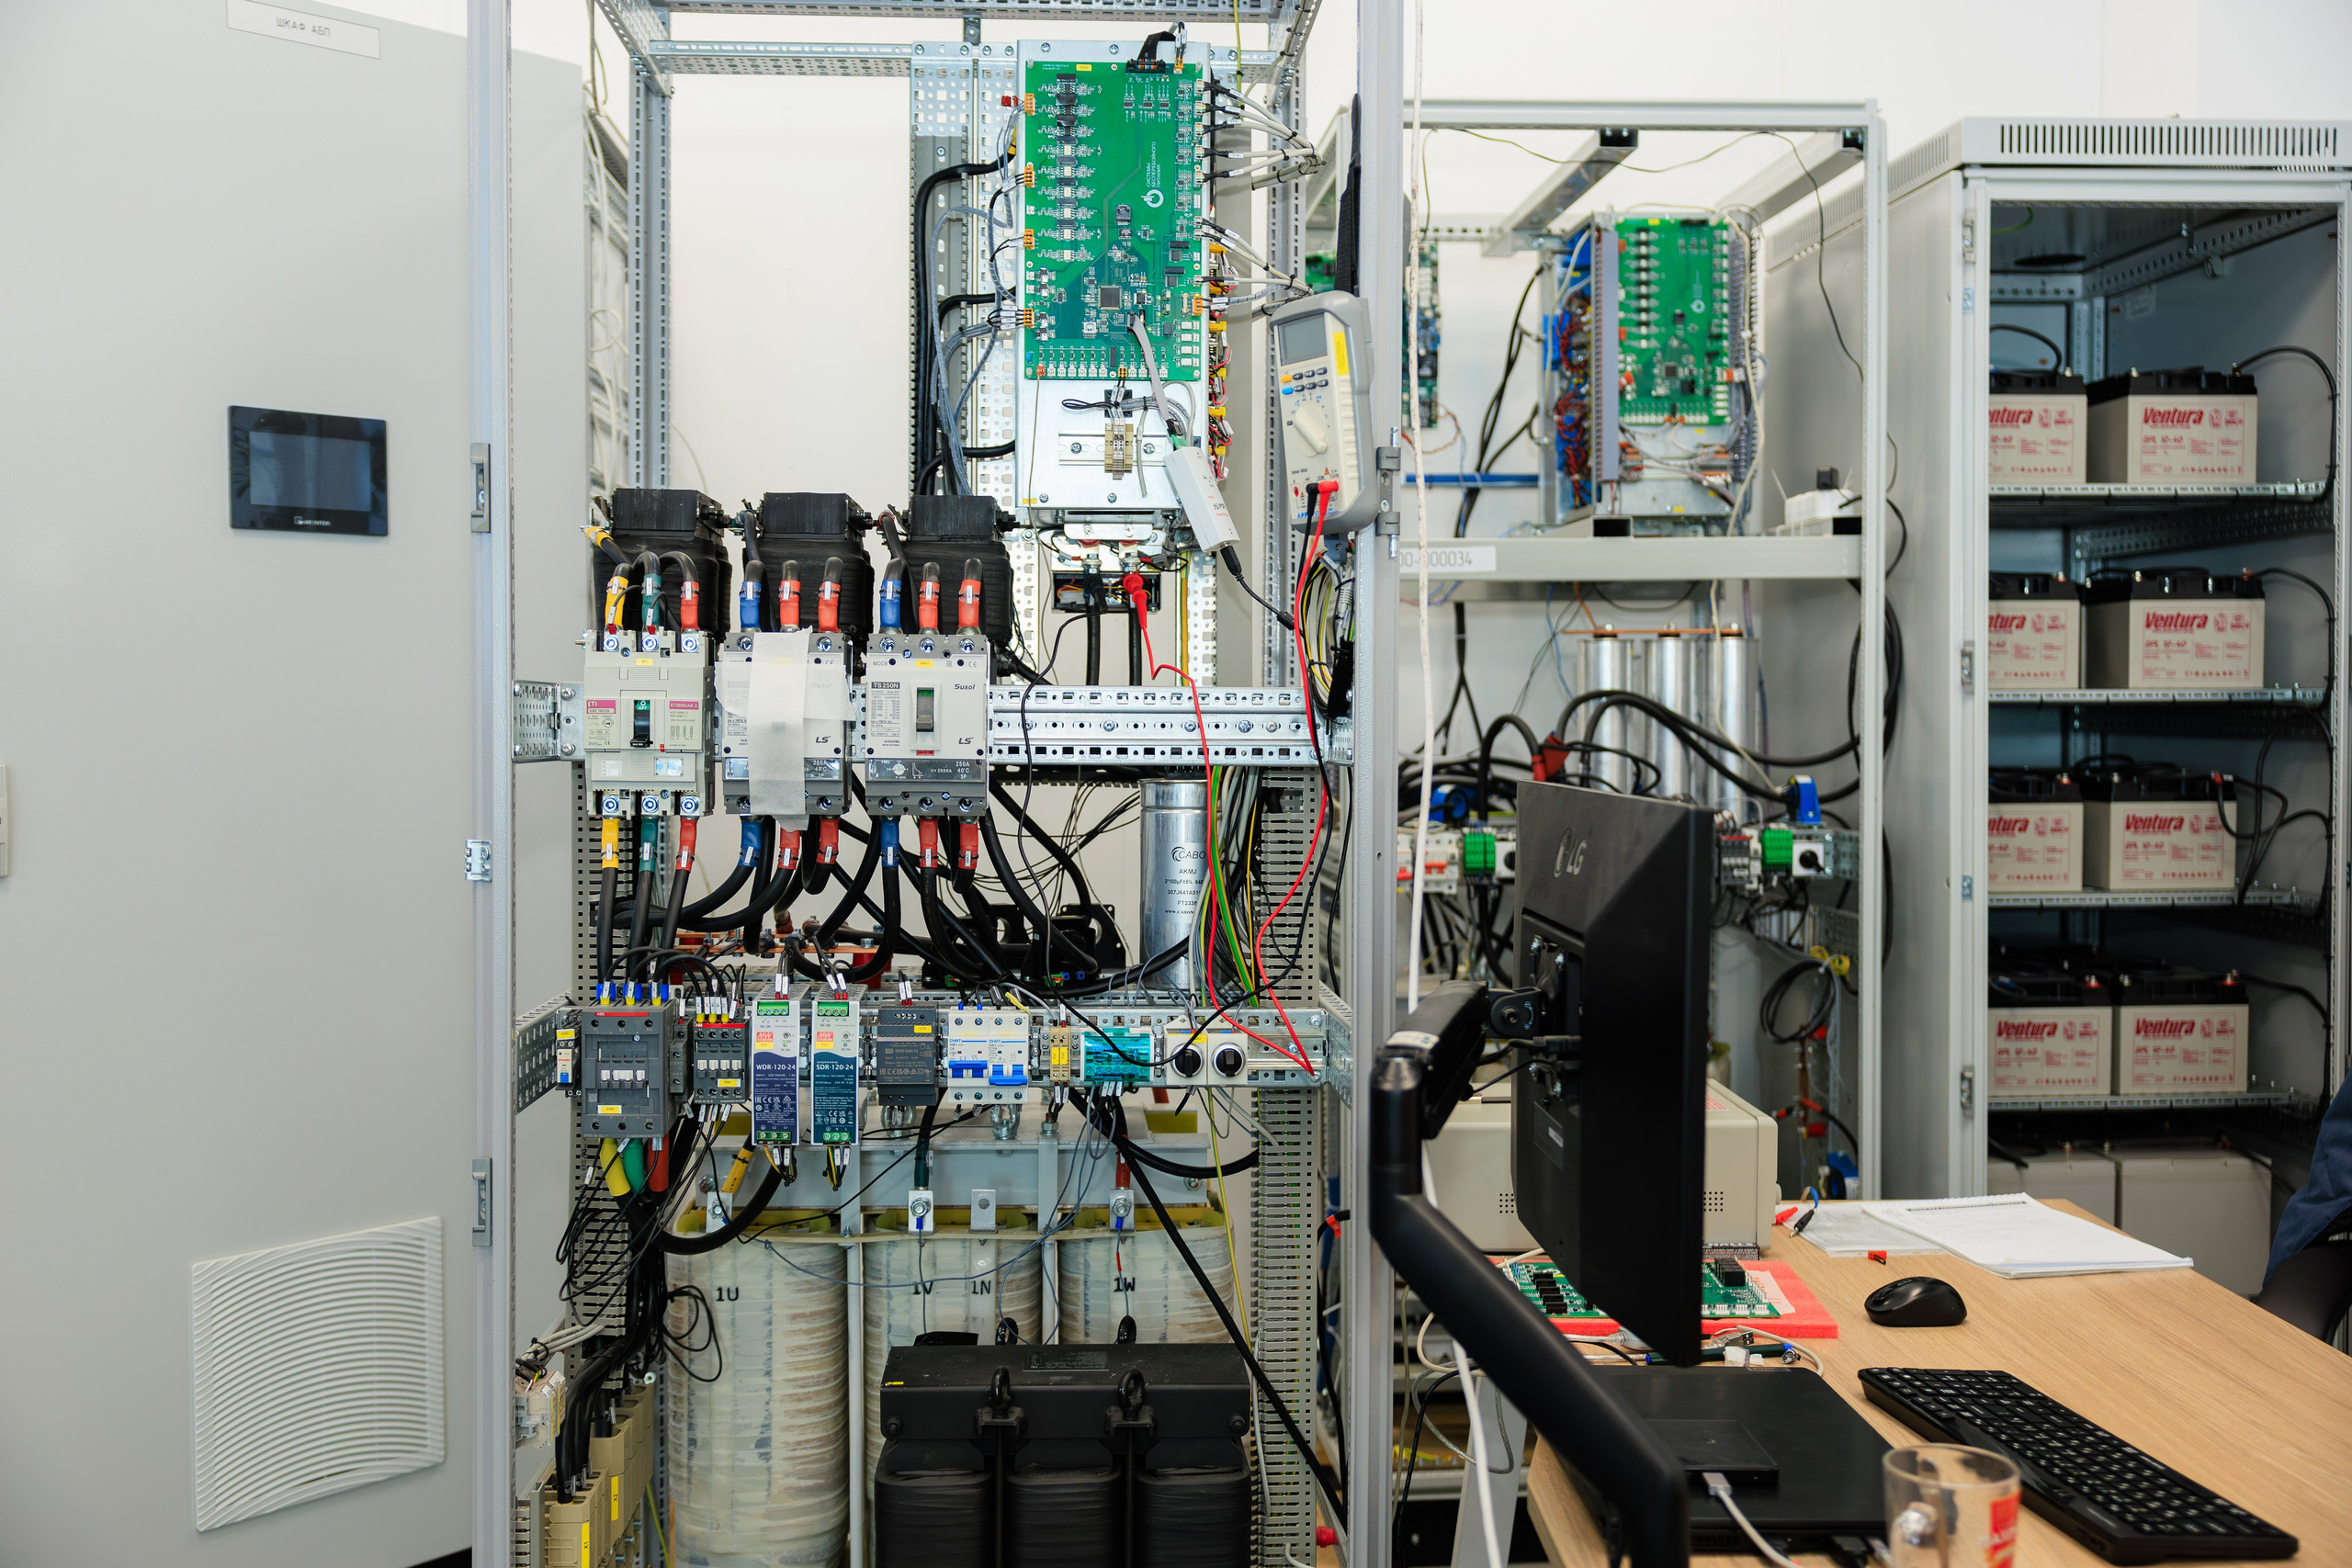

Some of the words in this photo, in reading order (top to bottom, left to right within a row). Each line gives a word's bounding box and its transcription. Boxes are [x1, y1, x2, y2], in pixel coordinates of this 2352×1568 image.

[276, 17, 306, 30] ШКАФ
[311, 24, 331, 37] АБП
[2143, 407, 2204, 424] Ventura
[2145, 612, 2209, 629] Ventura
[2125, 814, 2185, 831] Ventura
[1566, 839, 1587, 875] LG
[1996, 1020, 2058, 1038] Ventura
[2134, 1017, 2196, 1035] Ventura
[911, 1280, 933, 1295] 1V
[971, 1280, 991, 1295] 1N
[1113, 1278, 1136, 1292] 1W
[715, 1287, 740, 1302] 1U
[613, 1494, 618, 1503] X2
[583, 1540, 589, 1550] X1
